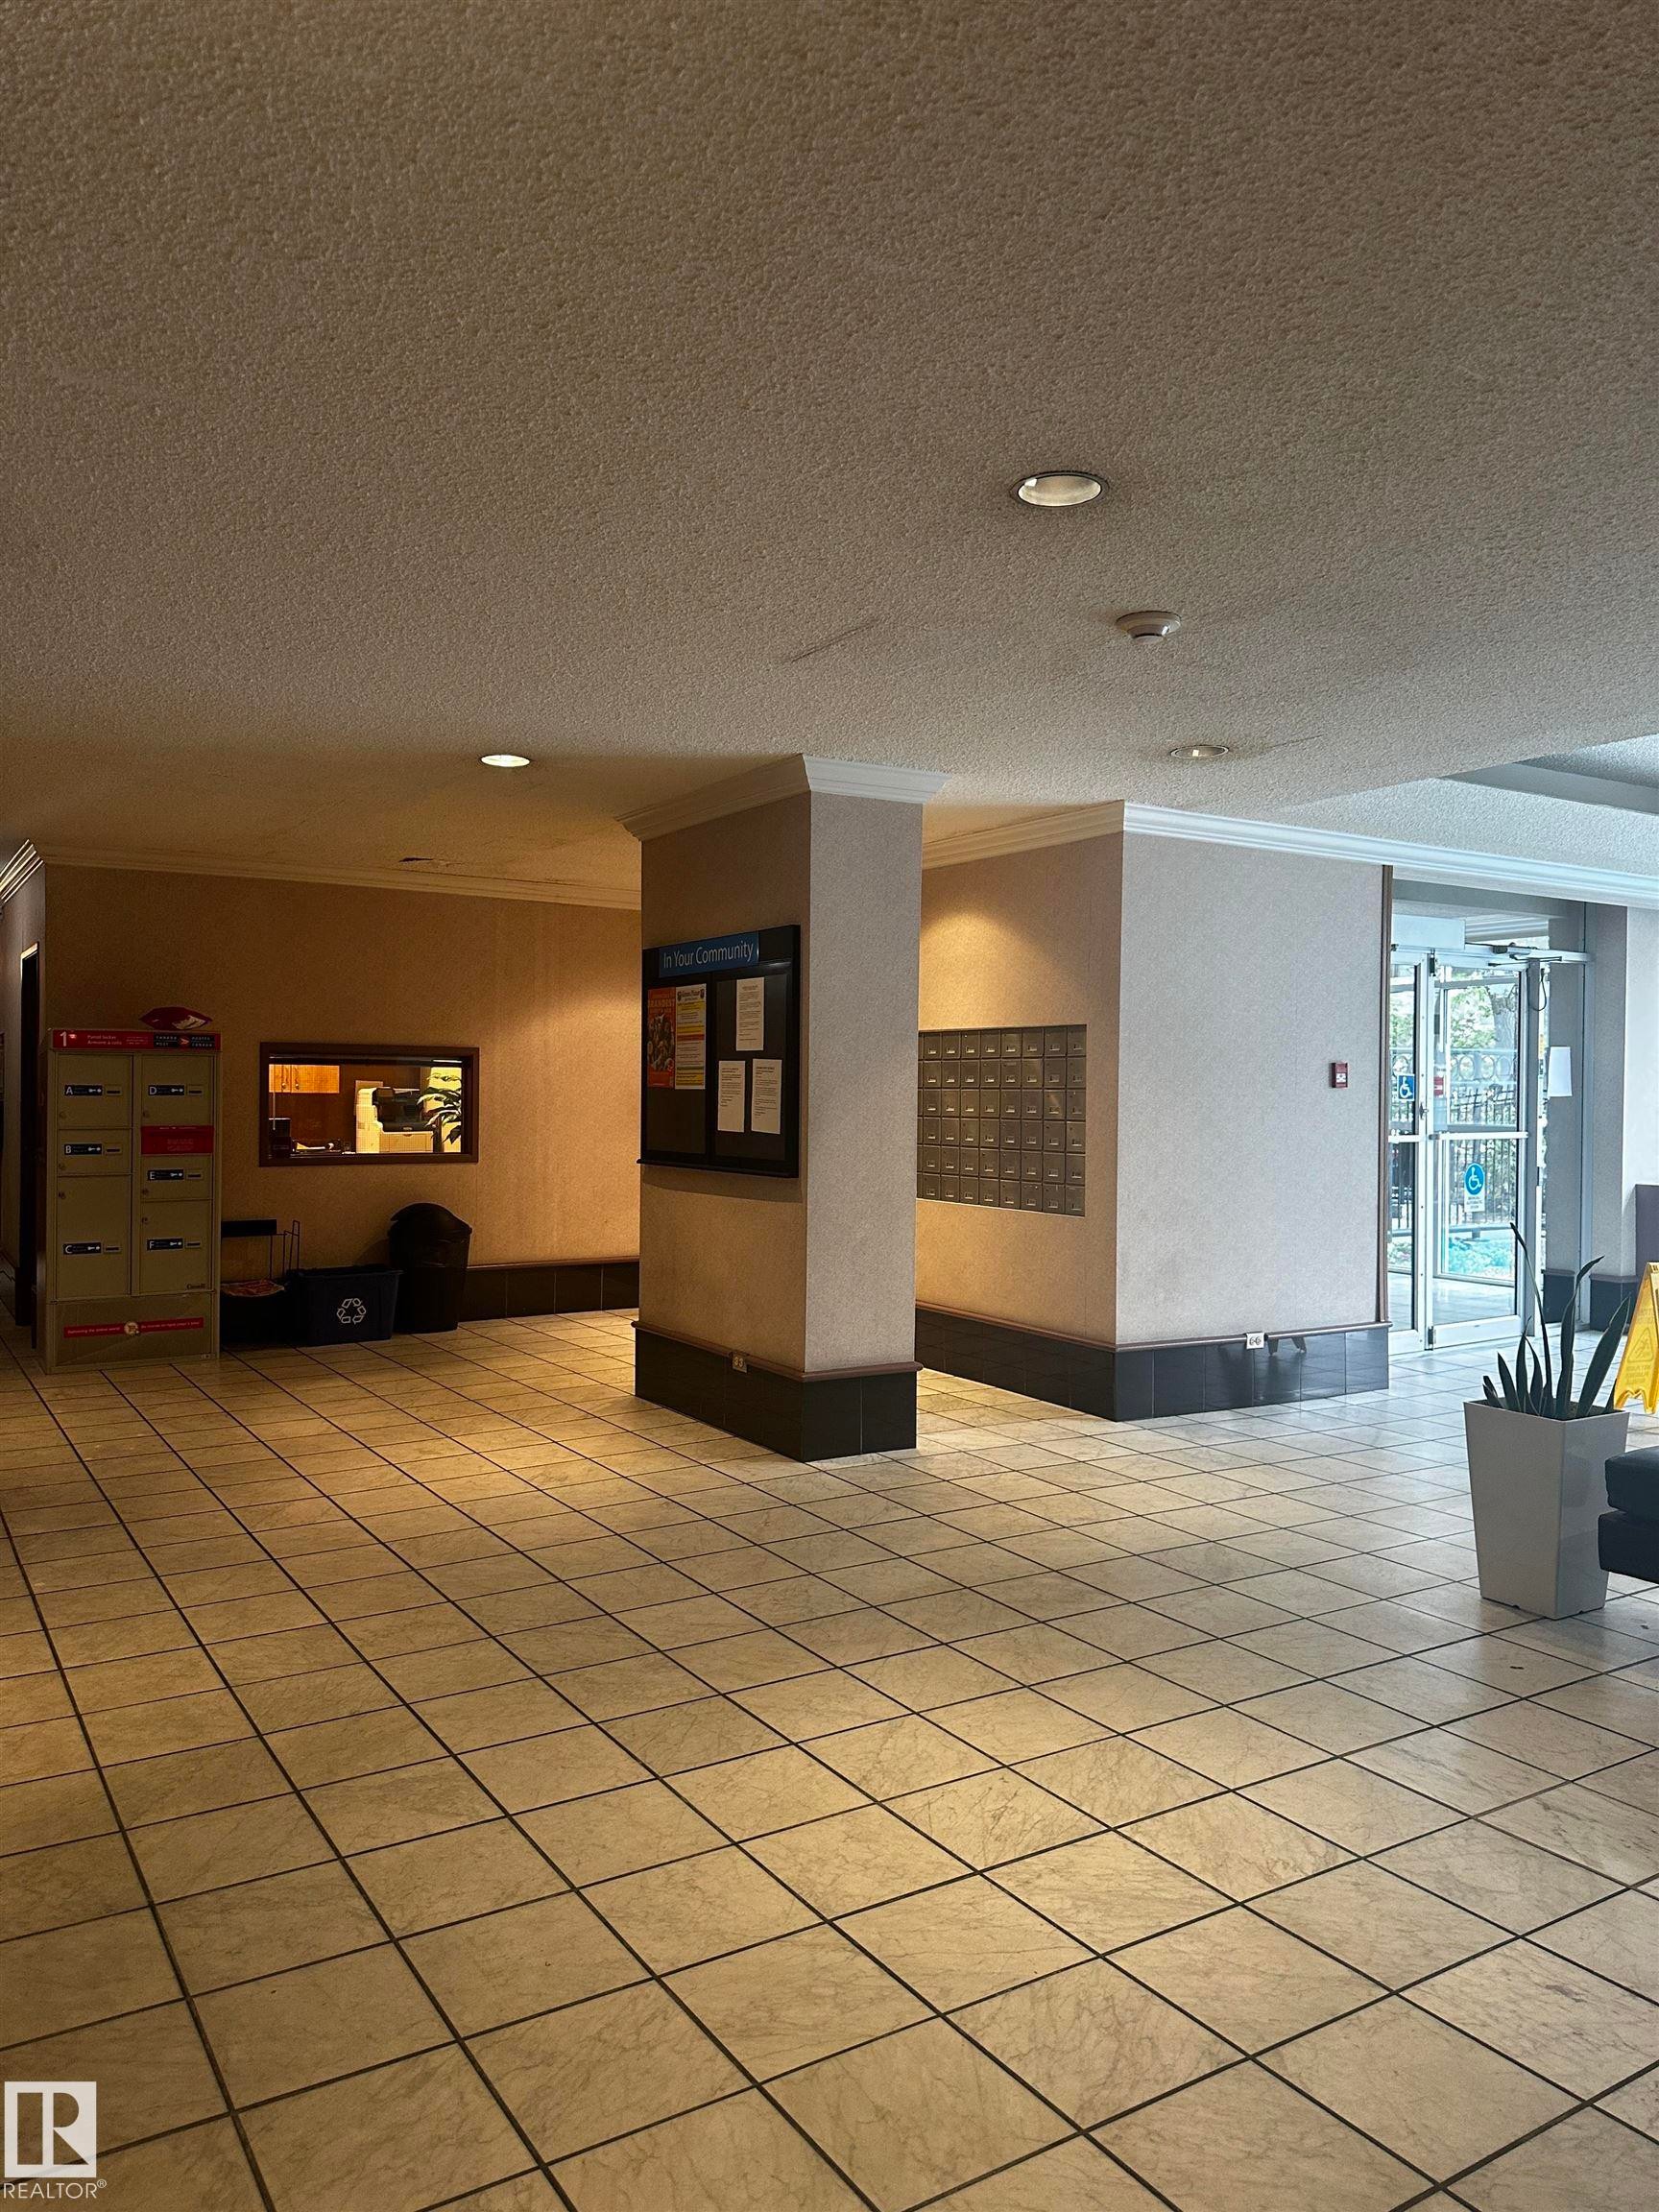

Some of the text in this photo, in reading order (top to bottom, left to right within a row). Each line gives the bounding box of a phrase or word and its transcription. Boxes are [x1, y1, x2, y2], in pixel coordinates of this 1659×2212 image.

[663, 940, 754, 969] In Your Community
[60, 1031, 67, 1047] 1
[65, 1086, 74, 1095] A
[149, 1086, 157, 1095] D
[64, 1144, 72, 1154] B
[149, 1170, 156, 1180] E
[64, 1244, 73, 1254] C
[149, 1240, 156, 1250] F
